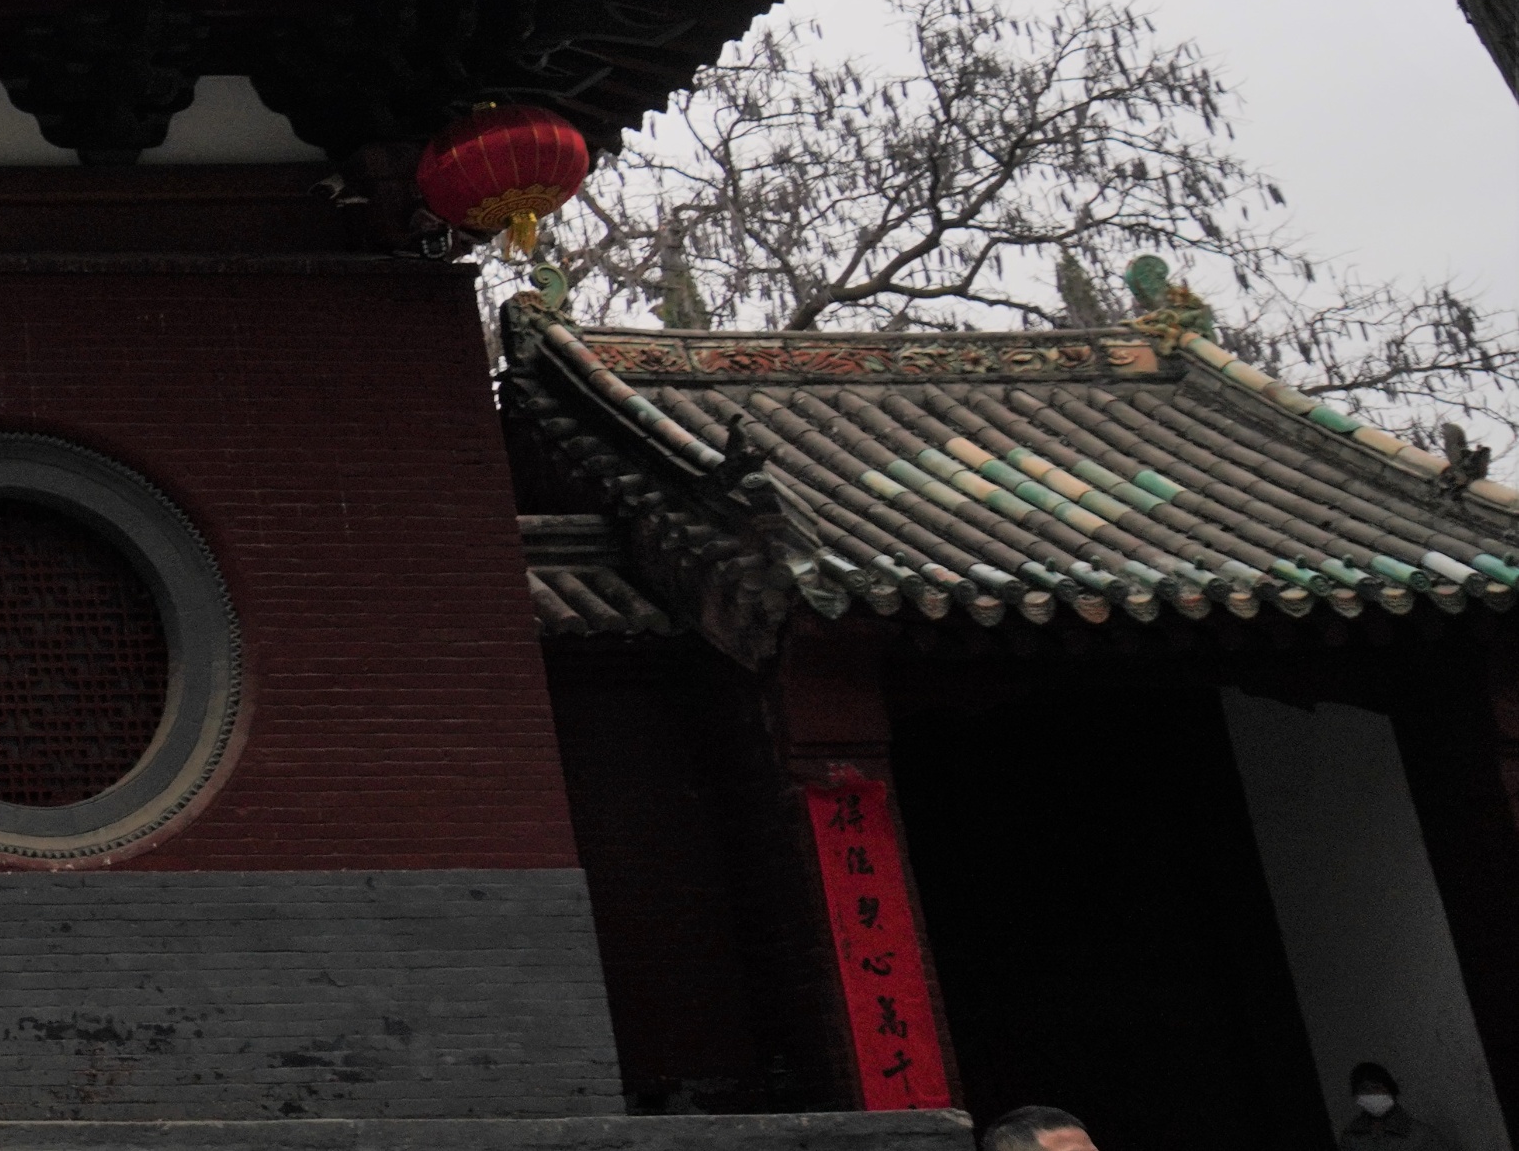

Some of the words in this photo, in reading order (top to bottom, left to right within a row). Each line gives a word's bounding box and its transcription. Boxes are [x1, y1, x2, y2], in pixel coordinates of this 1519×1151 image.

[828, 793, 918, 1109] 得法契心萬千
